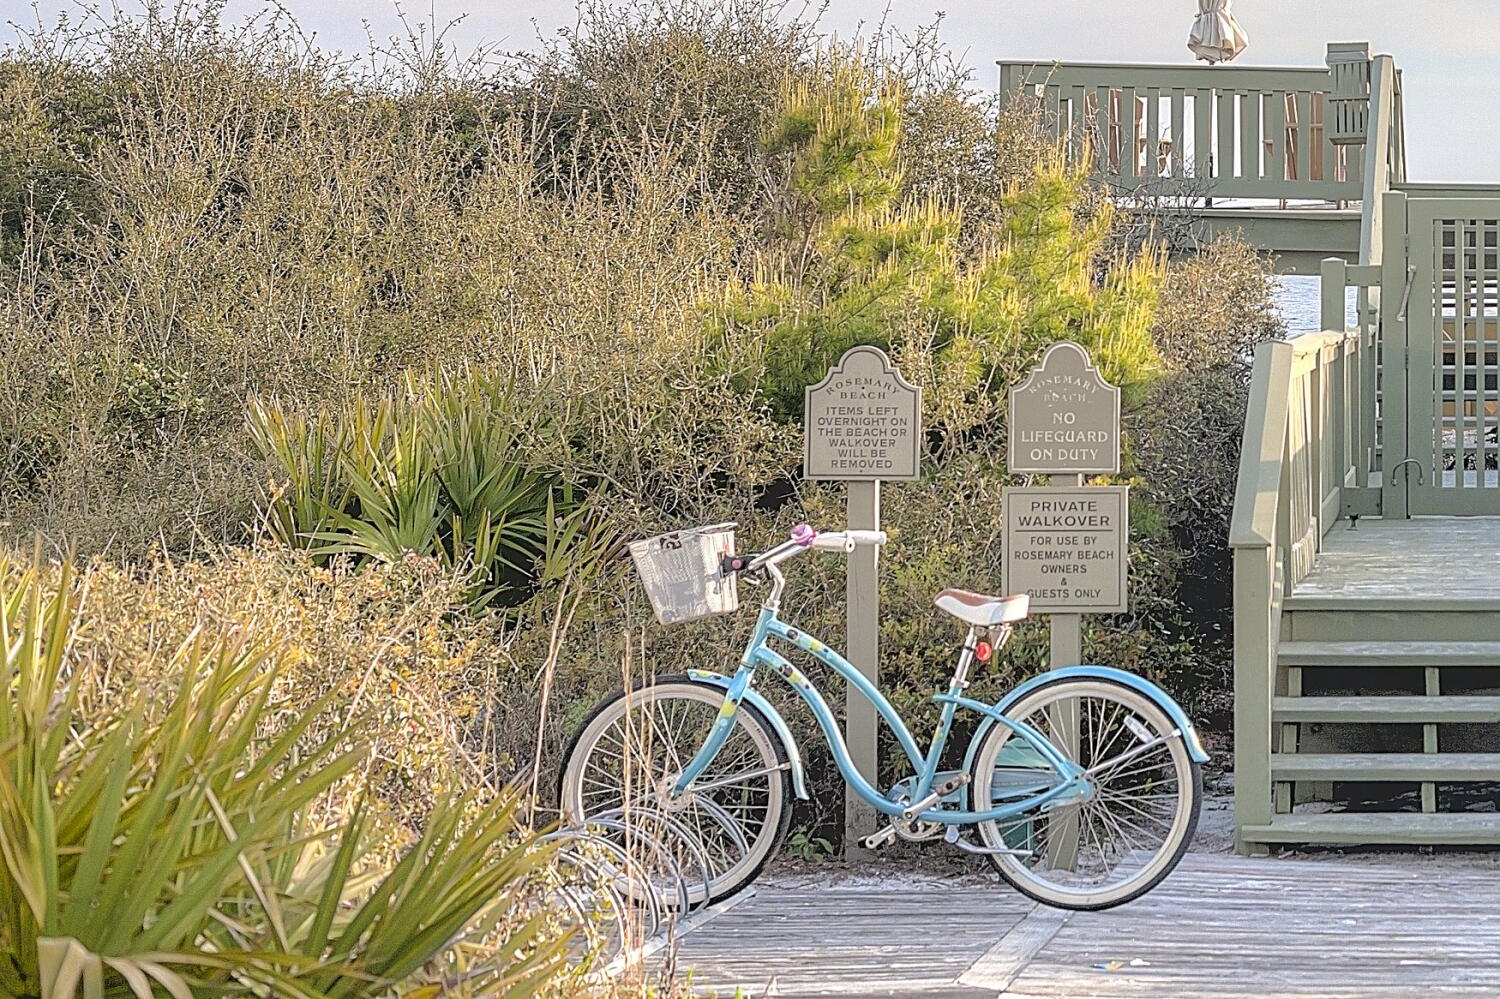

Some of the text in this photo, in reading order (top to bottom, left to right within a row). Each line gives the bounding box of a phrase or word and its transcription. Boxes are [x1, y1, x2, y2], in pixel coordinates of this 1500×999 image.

[826, 377, 900, 396] ROSEMARY
[1028, 375, 1100, 394] ROSEMARY
[840, 391, 886, 400] BEACH
[826, 406, 899, 416] ITEMS LEFT
[817, 417, 908, 426] OVERNIGHT ON
[1052, 412, 1076, 425] NO
[817, 427, 907, 437] THE BEACH OR
[1021, 431, 1109, 443] LIFEGUARD
[828, 438, 896, 448] WALKOVER
[838, 449, 887, 458] WILL BE
[1030, 448, 1099, 461] ON DUTY
[831, 459, 893, 469] REMOVED
[1031, 501, 1098, 512] PRIVATE
[1018, 515, 1110, 527] WALKOVER
[1030, 536, 1097, 546] FOR USE BY
[1014, 551, 1114, 560] ROSEMARY BEACH
[1041, 564, 1088, 574] OWNERS
[1060, 577, 1068, 586] &
[1026, 589, 1101, 599] GUESTS ONLY
